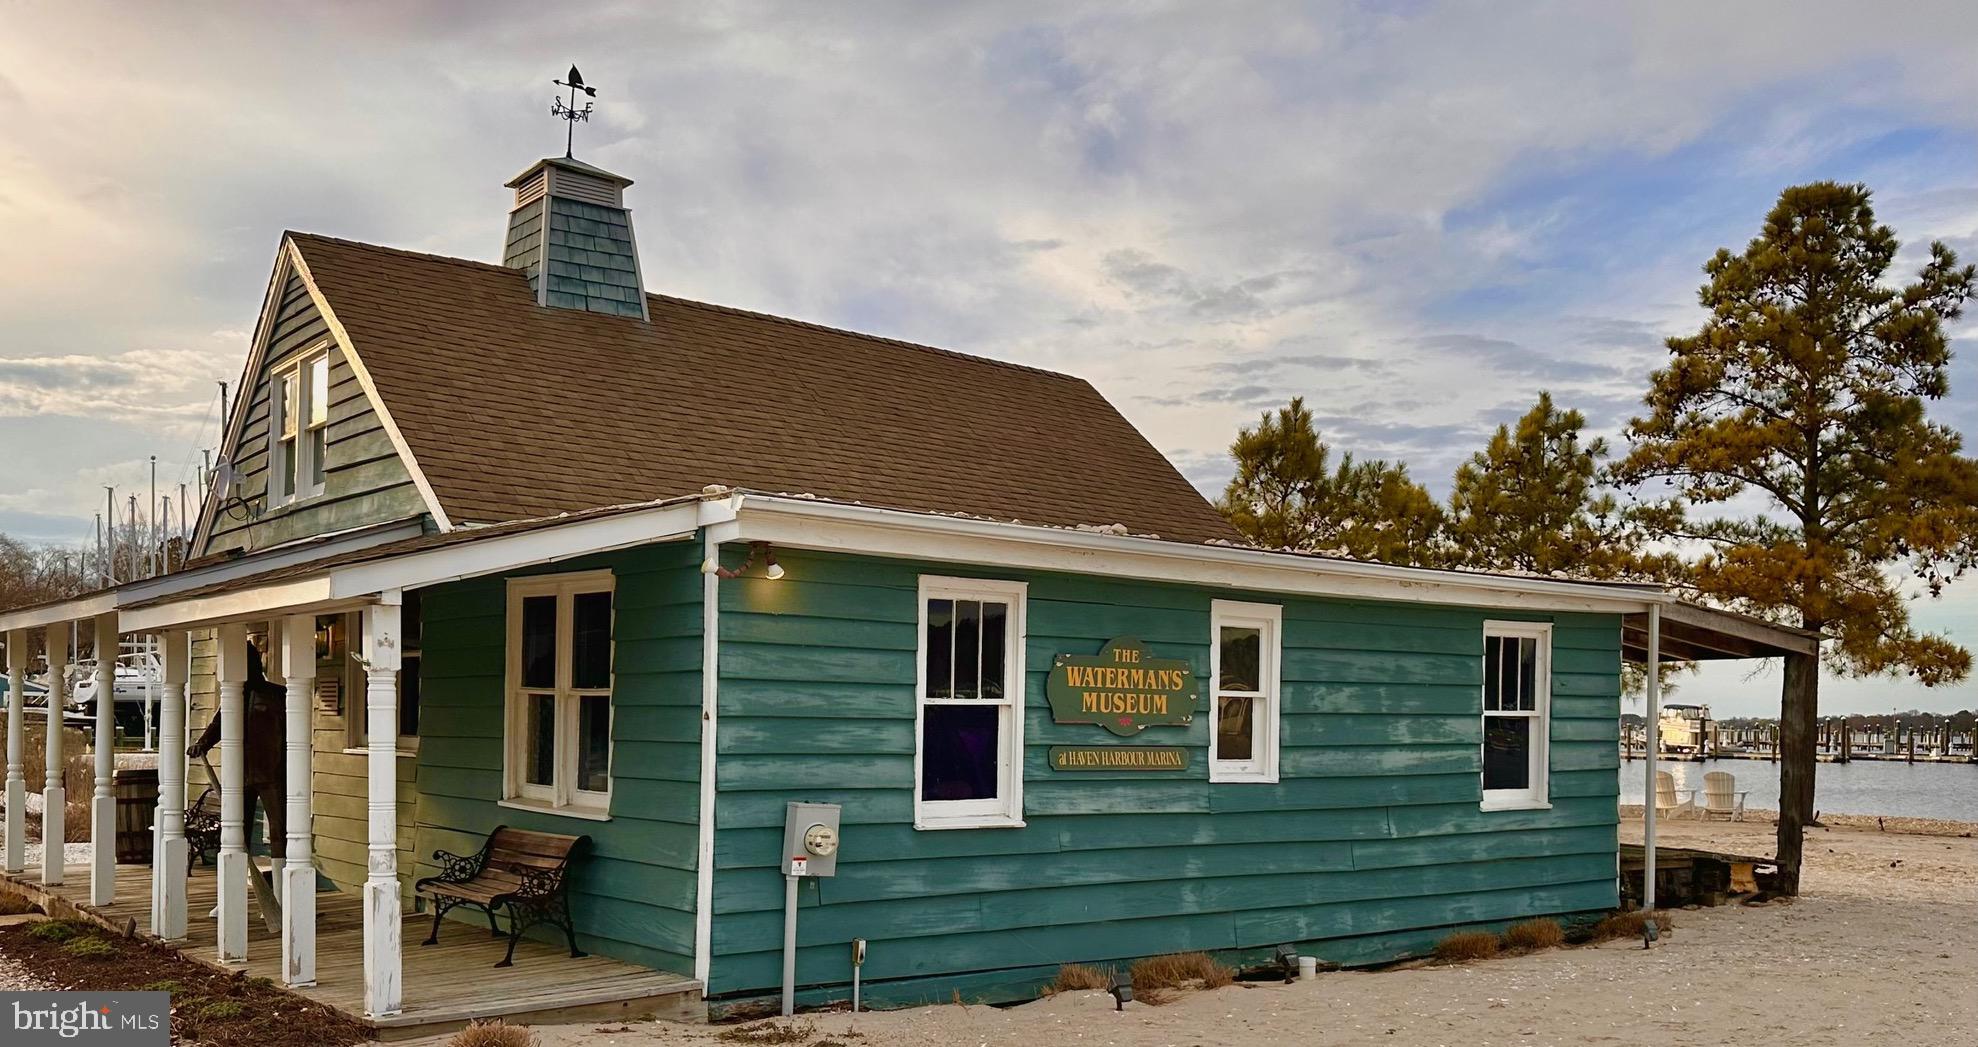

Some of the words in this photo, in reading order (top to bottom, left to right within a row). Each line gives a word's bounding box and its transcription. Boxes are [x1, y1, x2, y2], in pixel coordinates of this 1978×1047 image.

[1113, 648, 1140, 664] THE
[1066, 666, 1184, 691] WATERMAN'S
[1082, 692, 1168, 715] MUSEUM
[1058, 752, 1067, 766] at
[1069, 751, 1100, 766] HAVEN
[1101, 751, 1145, 766] HARBOUR
[1147, 752, 1182, 766] MARINA
